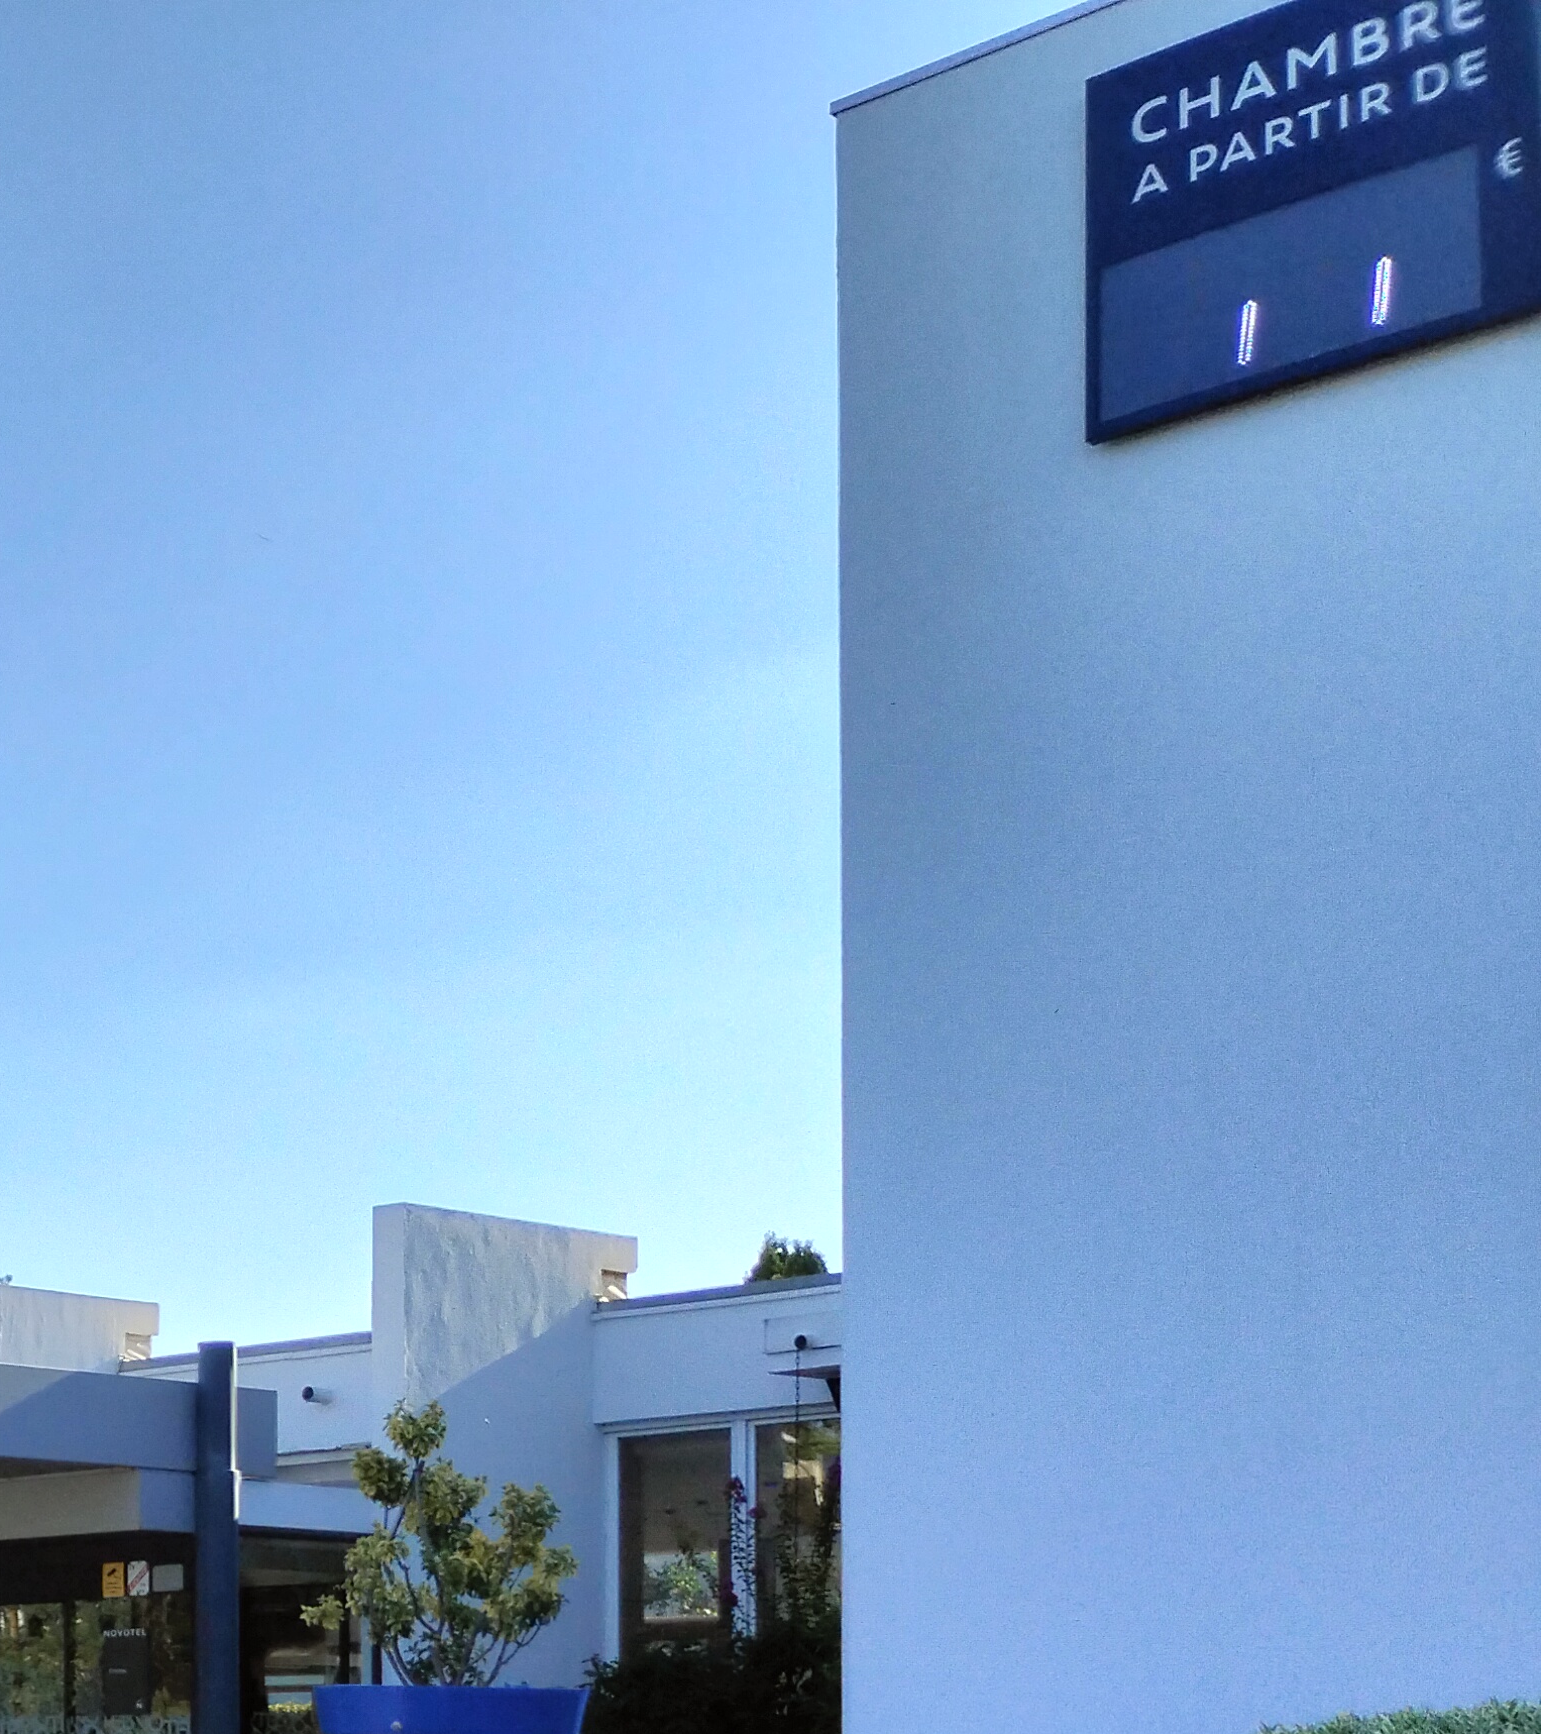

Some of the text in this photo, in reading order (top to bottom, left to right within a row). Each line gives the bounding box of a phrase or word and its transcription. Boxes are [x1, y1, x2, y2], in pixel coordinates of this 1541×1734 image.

[1131, 0, 1486, 143] CHAMBRE
[1132, 46, 1489, 204] A PARTIR DE
[1494, 137, 1524, 179] €
[103, 1627, 147, 1638] NOVOTEL
